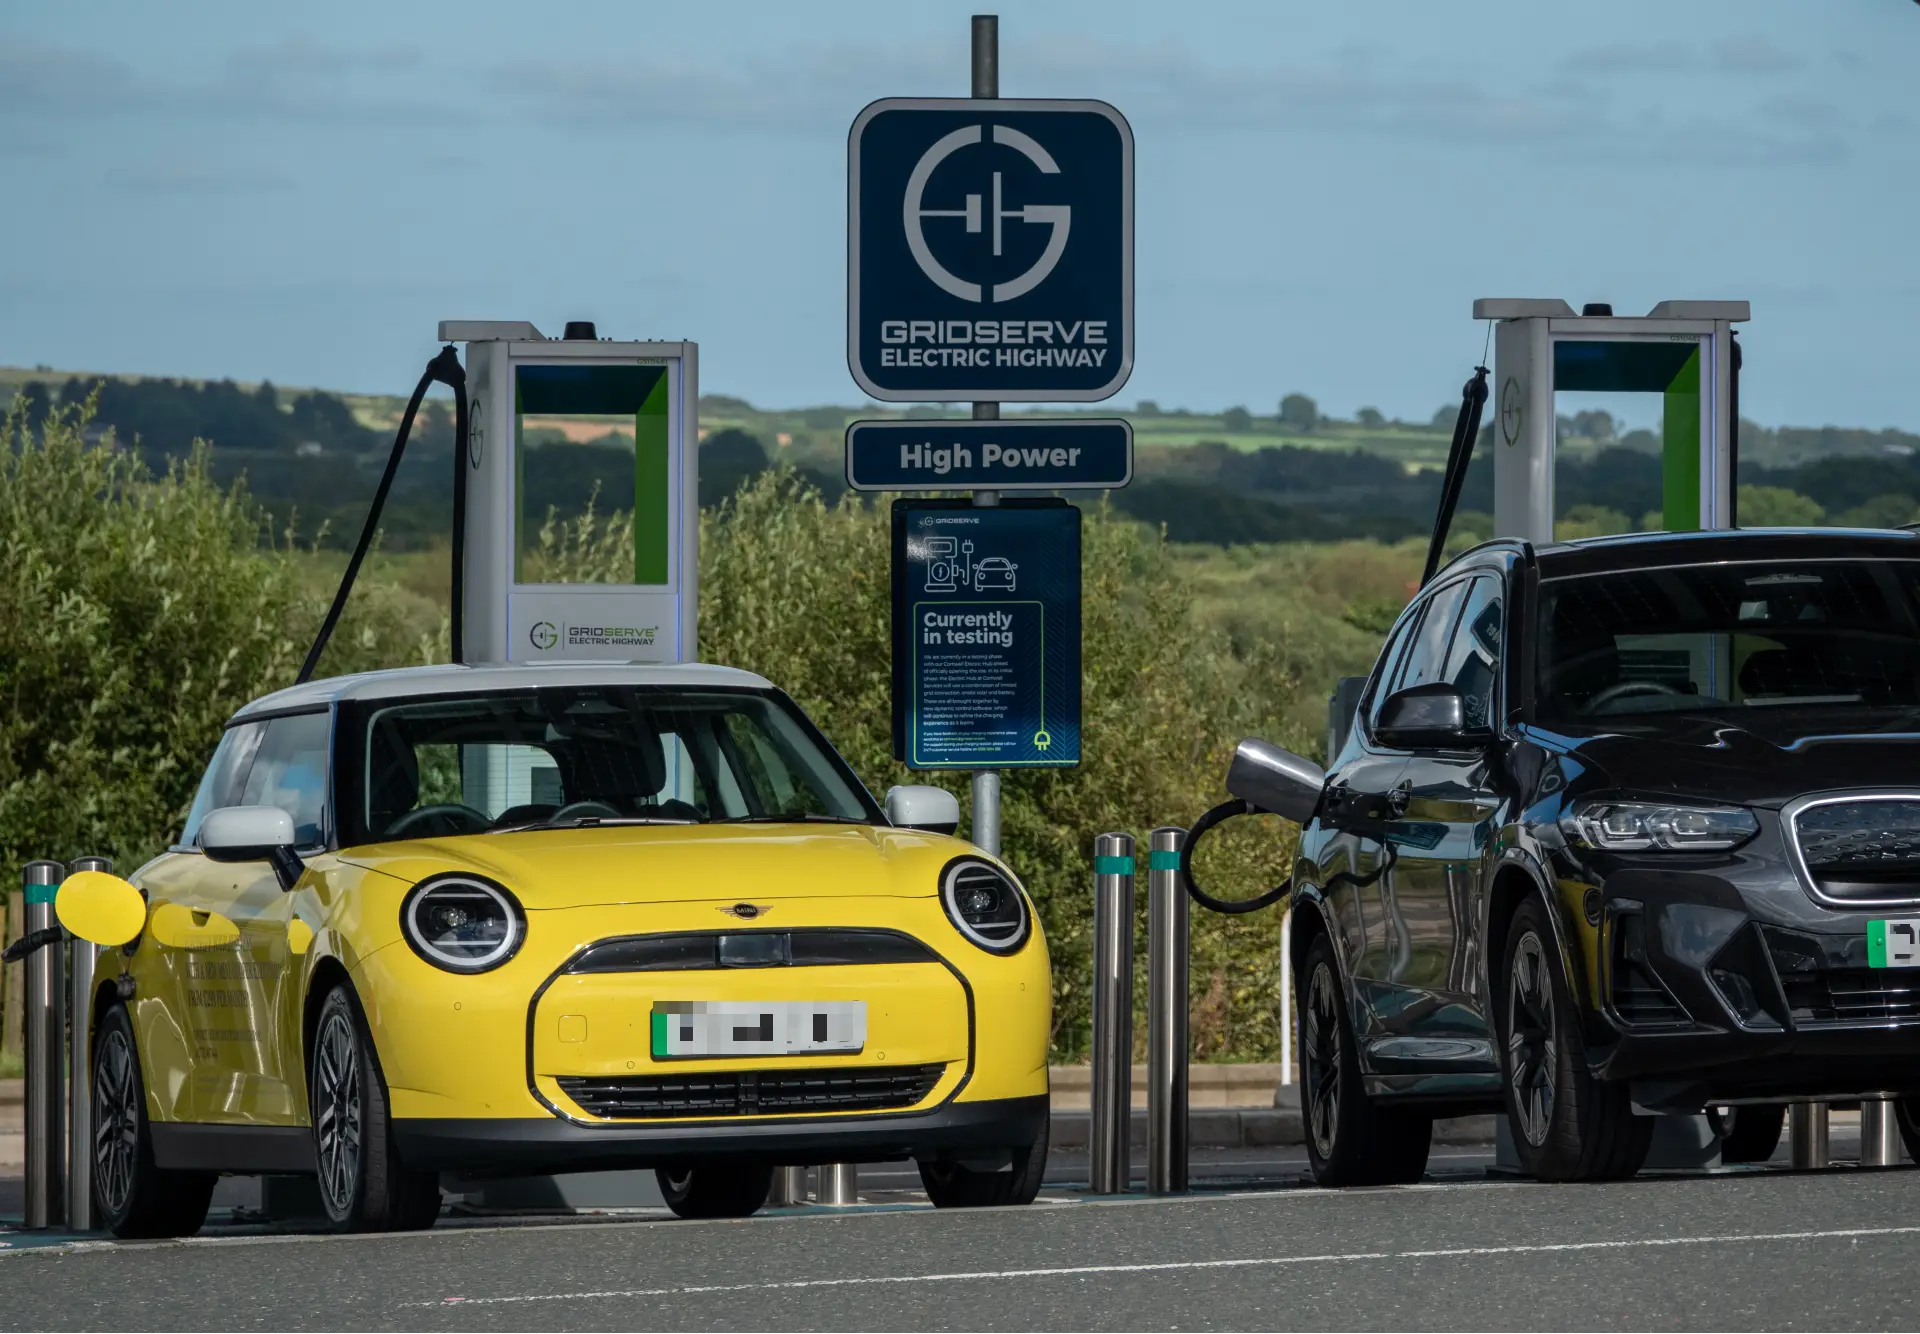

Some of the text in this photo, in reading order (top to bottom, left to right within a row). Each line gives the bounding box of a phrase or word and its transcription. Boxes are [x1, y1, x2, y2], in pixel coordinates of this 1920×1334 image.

[881, 320, 1108, 345] GRIDSERVE
[881, 348, 1108, 368] ELECTRIC HIGHWAY
[900, 442, 1082, 475] High Power
[924, 610, 1013, 631] Currently
[569, 637, 654, 646] ELECTRIC HIGHWAY
[924, 628, 1013, 647] in testing
